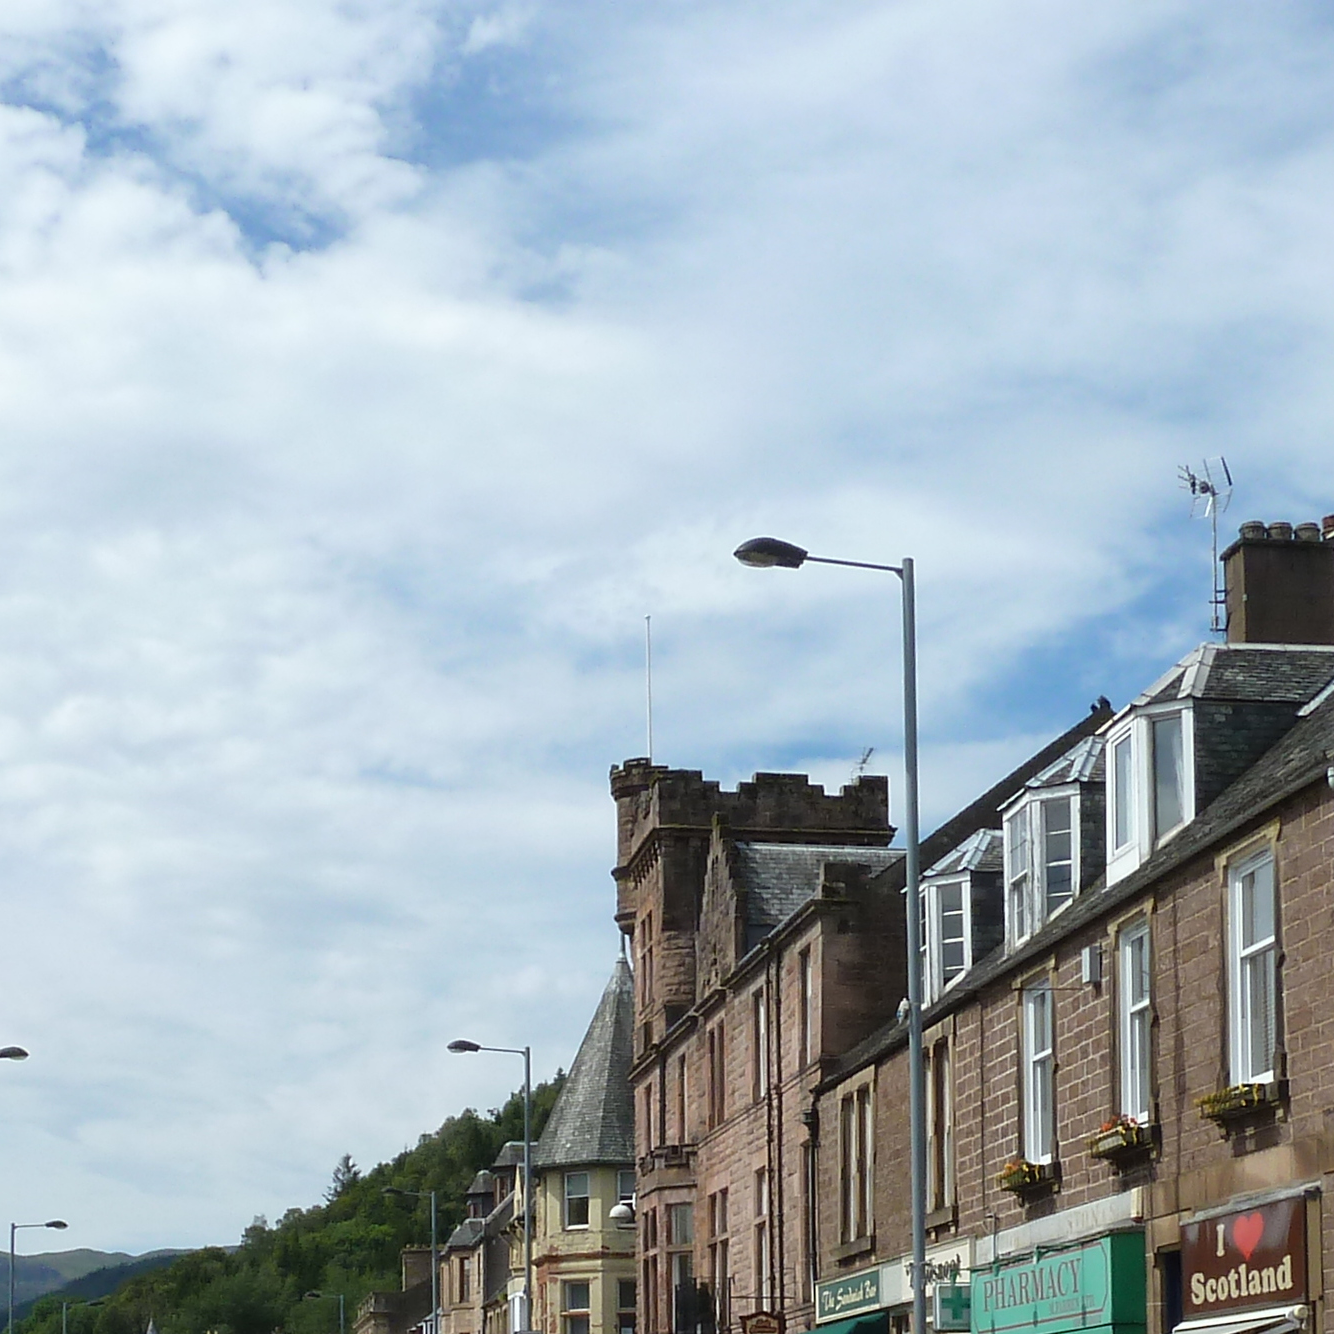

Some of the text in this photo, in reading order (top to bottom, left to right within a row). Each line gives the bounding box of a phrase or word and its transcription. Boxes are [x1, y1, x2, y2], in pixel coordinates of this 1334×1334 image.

[1216, 1223, 1225, 1257] I
[822, 1280, 877, 1311] The Sandwich Bar
[983, 1257, 1082, 1312] PHARMACY
[1191, 1254, 1294, 1305] Scotland
